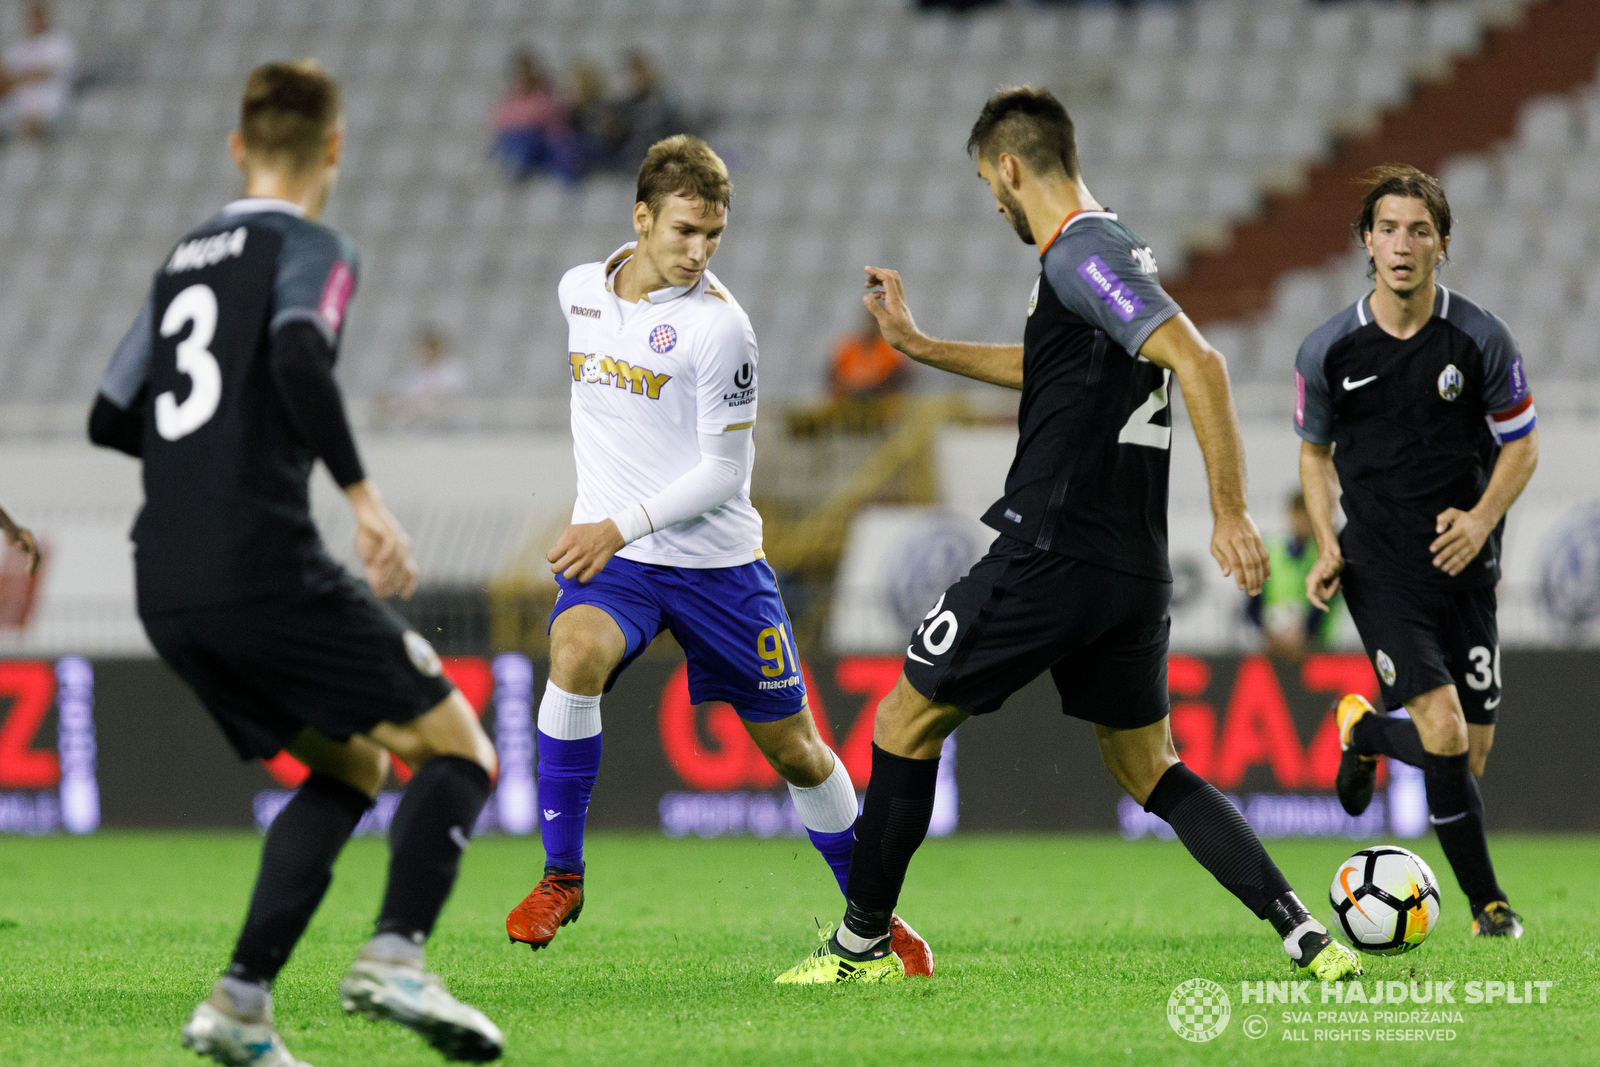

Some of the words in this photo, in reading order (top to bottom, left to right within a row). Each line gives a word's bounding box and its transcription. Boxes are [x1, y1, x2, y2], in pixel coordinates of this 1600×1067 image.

[167, 225, 249, 275] MUSA
[570, 304, 601, 319] macron
[1086, 261, 1112, 292] Trans
[1109, 289, 1135, 314] Auto
[155, 282, 223, 442] 3
[568, 351, 673, 401] TOMMY
[723, 387, 757, 401] ULTR
[728, 396, 757, 408] EUROP
[757, 622, 797, 678] 91
[758, 676, 800, 690] macron
[660, 655, 906, 790] GZ
[843, 968, 867, 984] das
